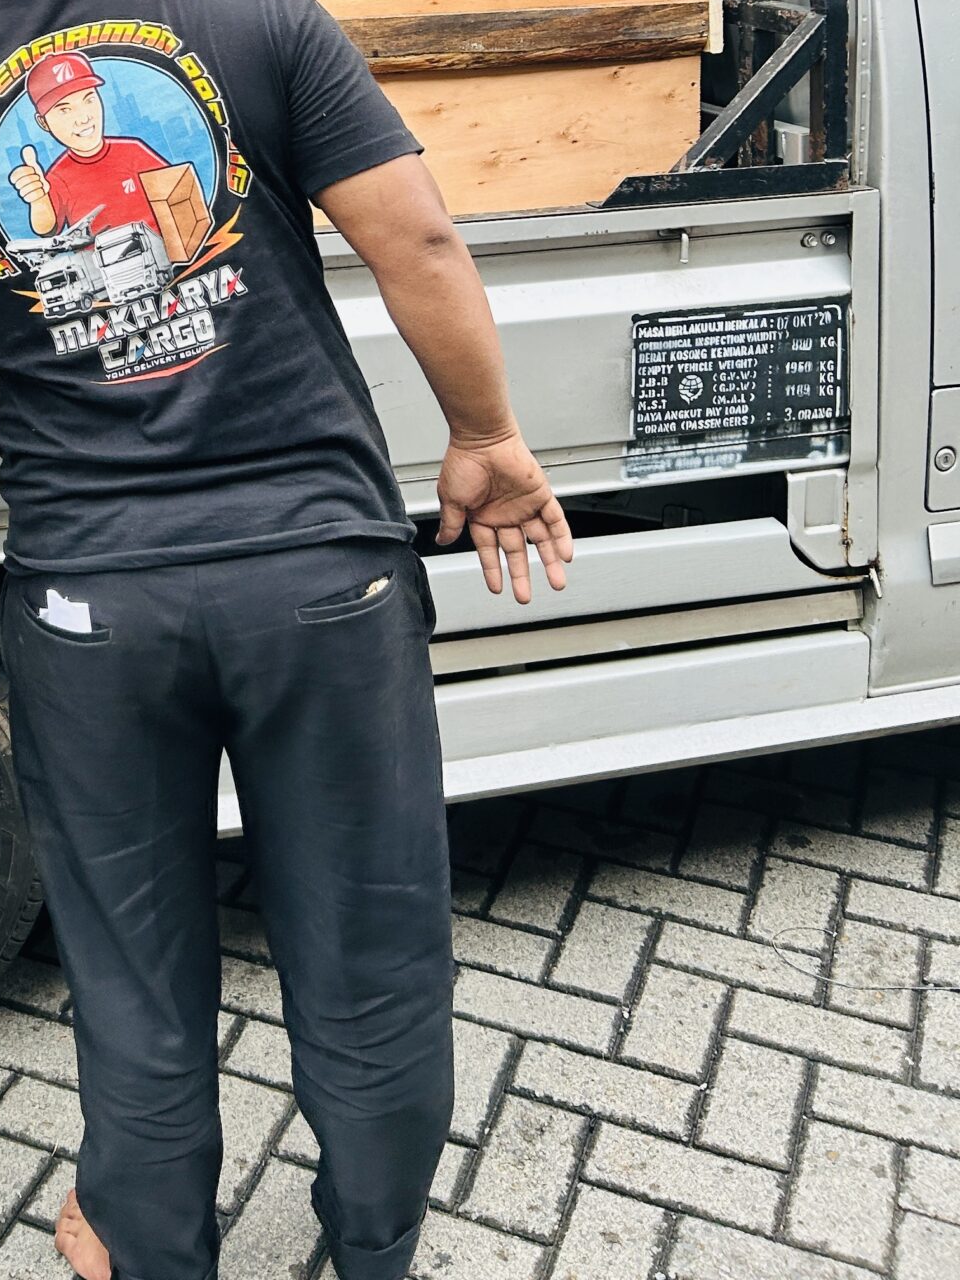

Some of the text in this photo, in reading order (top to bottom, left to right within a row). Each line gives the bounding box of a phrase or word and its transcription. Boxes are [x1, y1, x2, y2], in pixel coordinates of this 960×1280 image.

[48, 265, 247, 355] MAKHARYA
[99, 310, 215, 371] CARGO
[638, 326, 665, 339] MASA
[639, 351, 668, 364] BERAT
[670, 348, 708, 362] KOSONG
[820, 336, 835, 348] KG
[106, 369, 132, 380] YOUR
[134, 355, 177, 373] DELIVERY
[677, 361, 713, 373] VEHICLE
[819, 360, 834, 372] KG
[819, 372, 834, 383] KG
[819, 384, 834, 396] KG
[637, 404, 749, 423] DAYA ANGKUT PAY LOAD
